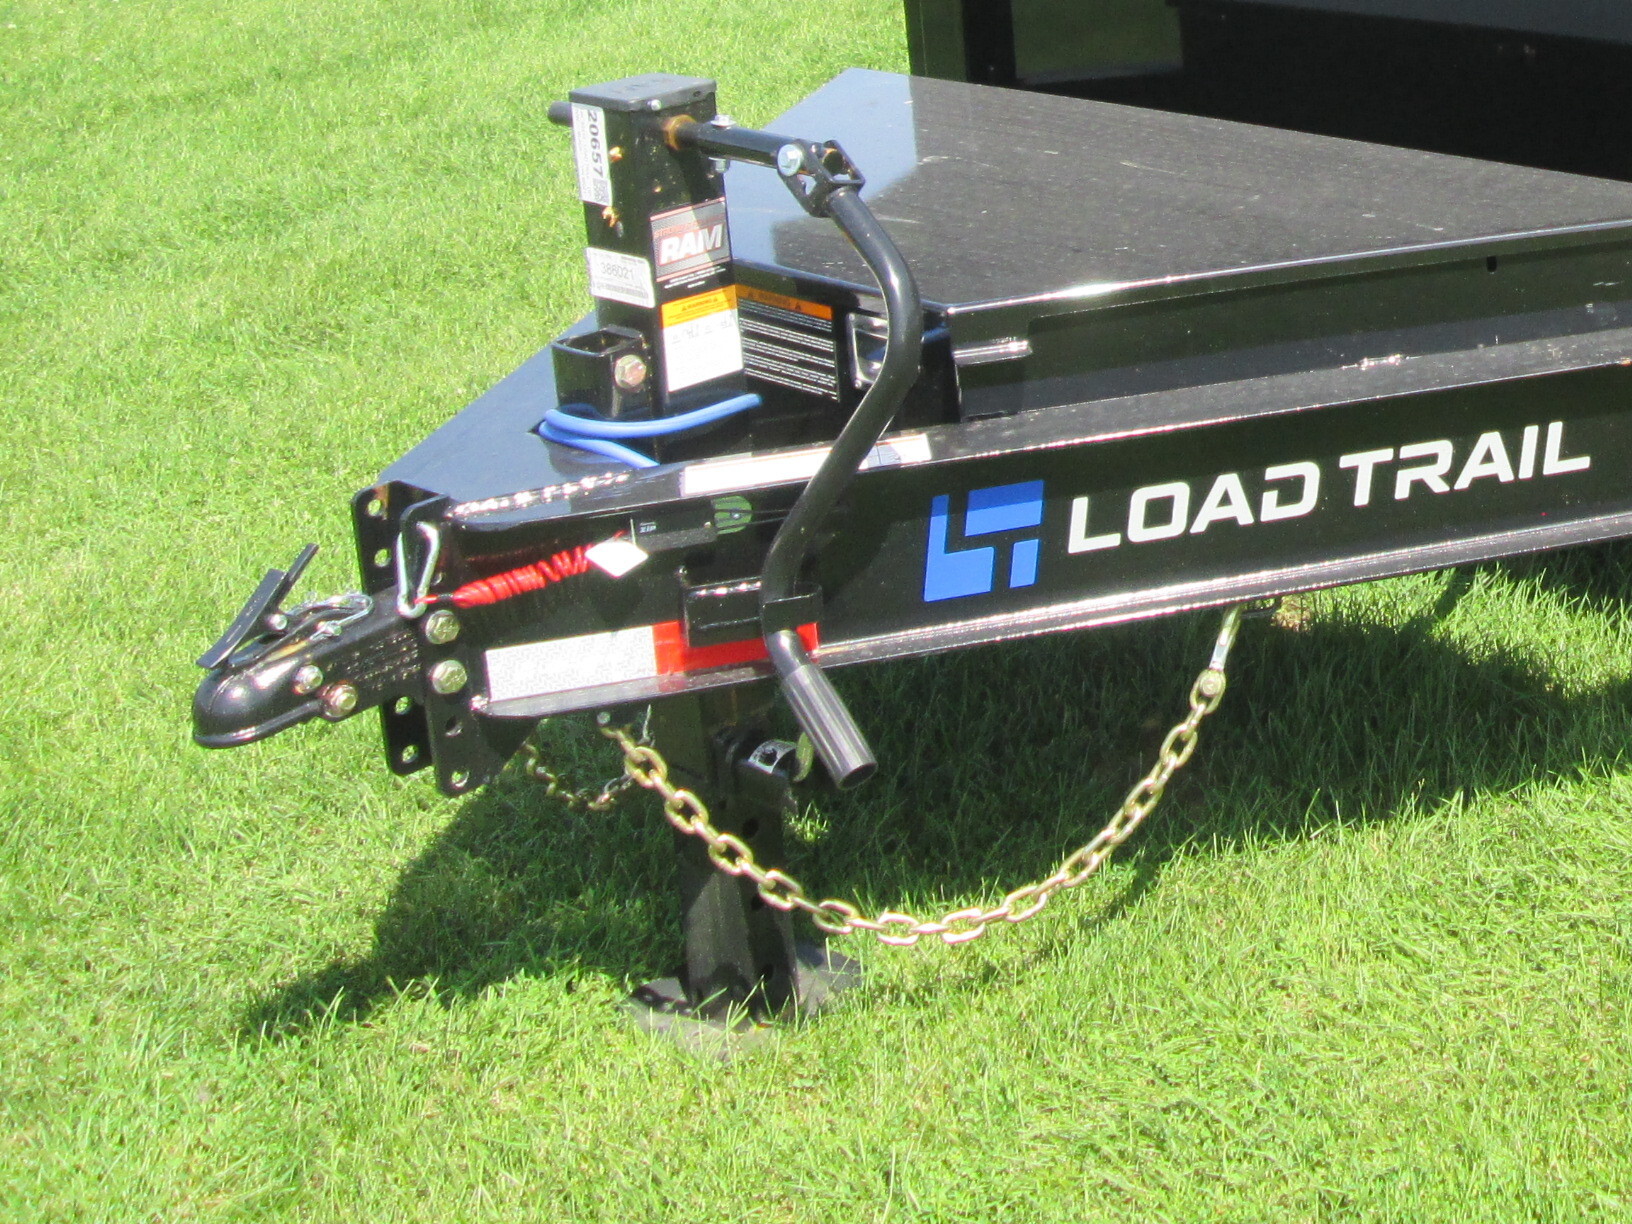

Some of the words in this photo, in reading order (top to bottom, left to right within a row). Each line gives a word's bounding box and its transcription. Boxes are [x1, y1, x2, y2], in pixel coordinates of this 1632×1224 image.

[587, 109, 604, 178] 20657
[660, 224, 723, 265] RAM
[1068, 462, 1318, 554] LOAD
[1339, 421, 1591, 507] TRAIL
